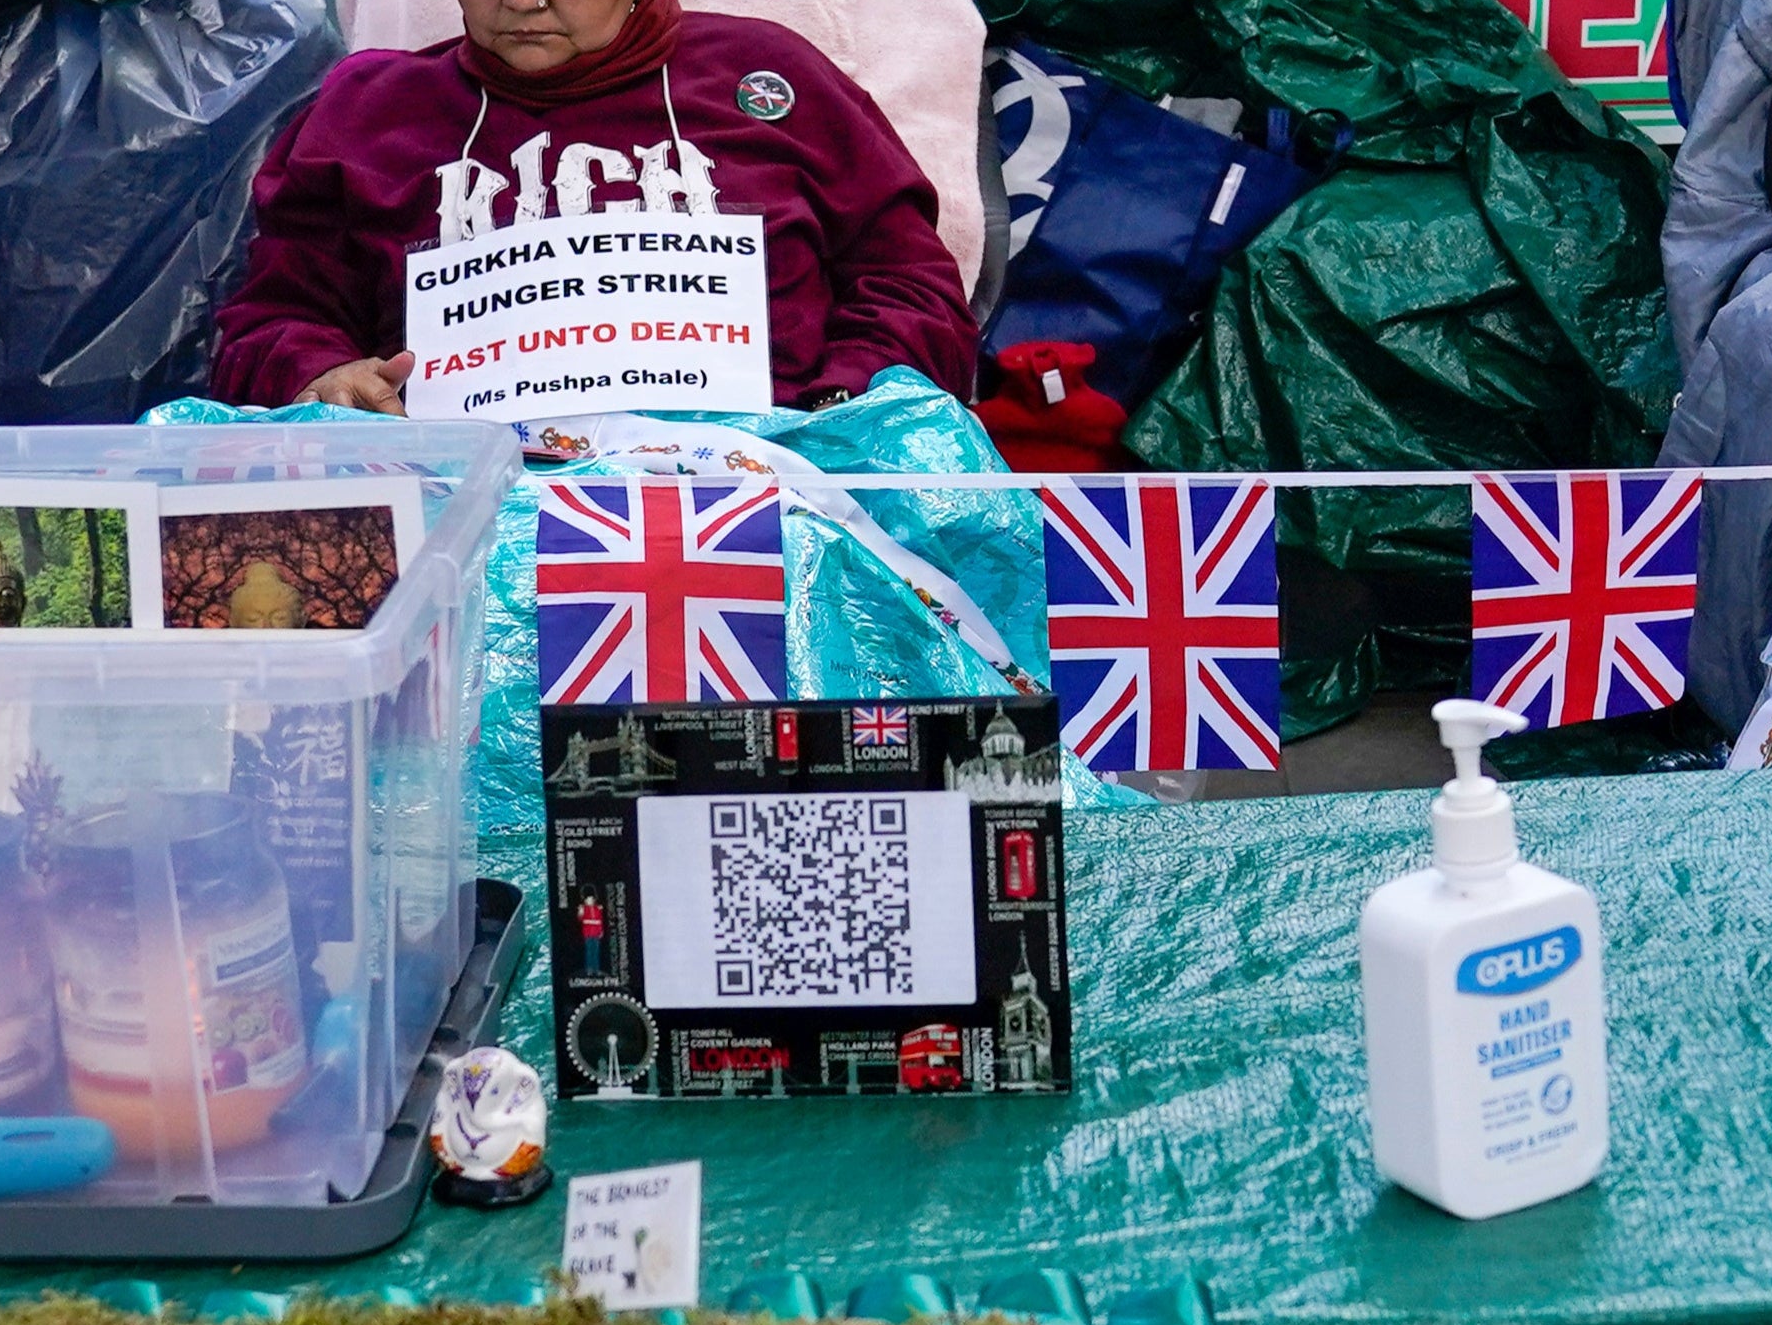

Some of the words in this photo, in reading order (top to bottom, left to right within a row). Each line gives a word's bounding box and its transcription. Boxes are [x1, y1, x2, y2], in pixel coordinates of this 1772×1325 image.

[414, 239, 556, 292] GURKHA
[566, 232, 757, 257] VETERANS
[443, 276, 586, 327] HUNGER
[597, 273, 729, 296] STRIKE
[424, 339, 507, 381] FAST
[517, 322, 617, 354] UNTO
[630, 321, 751, 345] DEATH
[463, 388, 507, 413] (Ms
[514, 373, 612, 398] Pushpa
[620, 368, 709, 392] Ghale)
[854, 745, 909, 761] LONDON
[1499, 999, 1550, 1032] HAND
[690, 1038, 728, 1049] COVENT
[730, 1037, 772, 1048] GARDEN
[690, 1048, 790, 1070] LONDON
[829, 1041, 870, 1052] HOLLAND
[871, 1041, 896, 1051] PARK
[981, 1027, 996, 1092] LONDON
[1476, 1019, 1572, 1066] SANITISER
